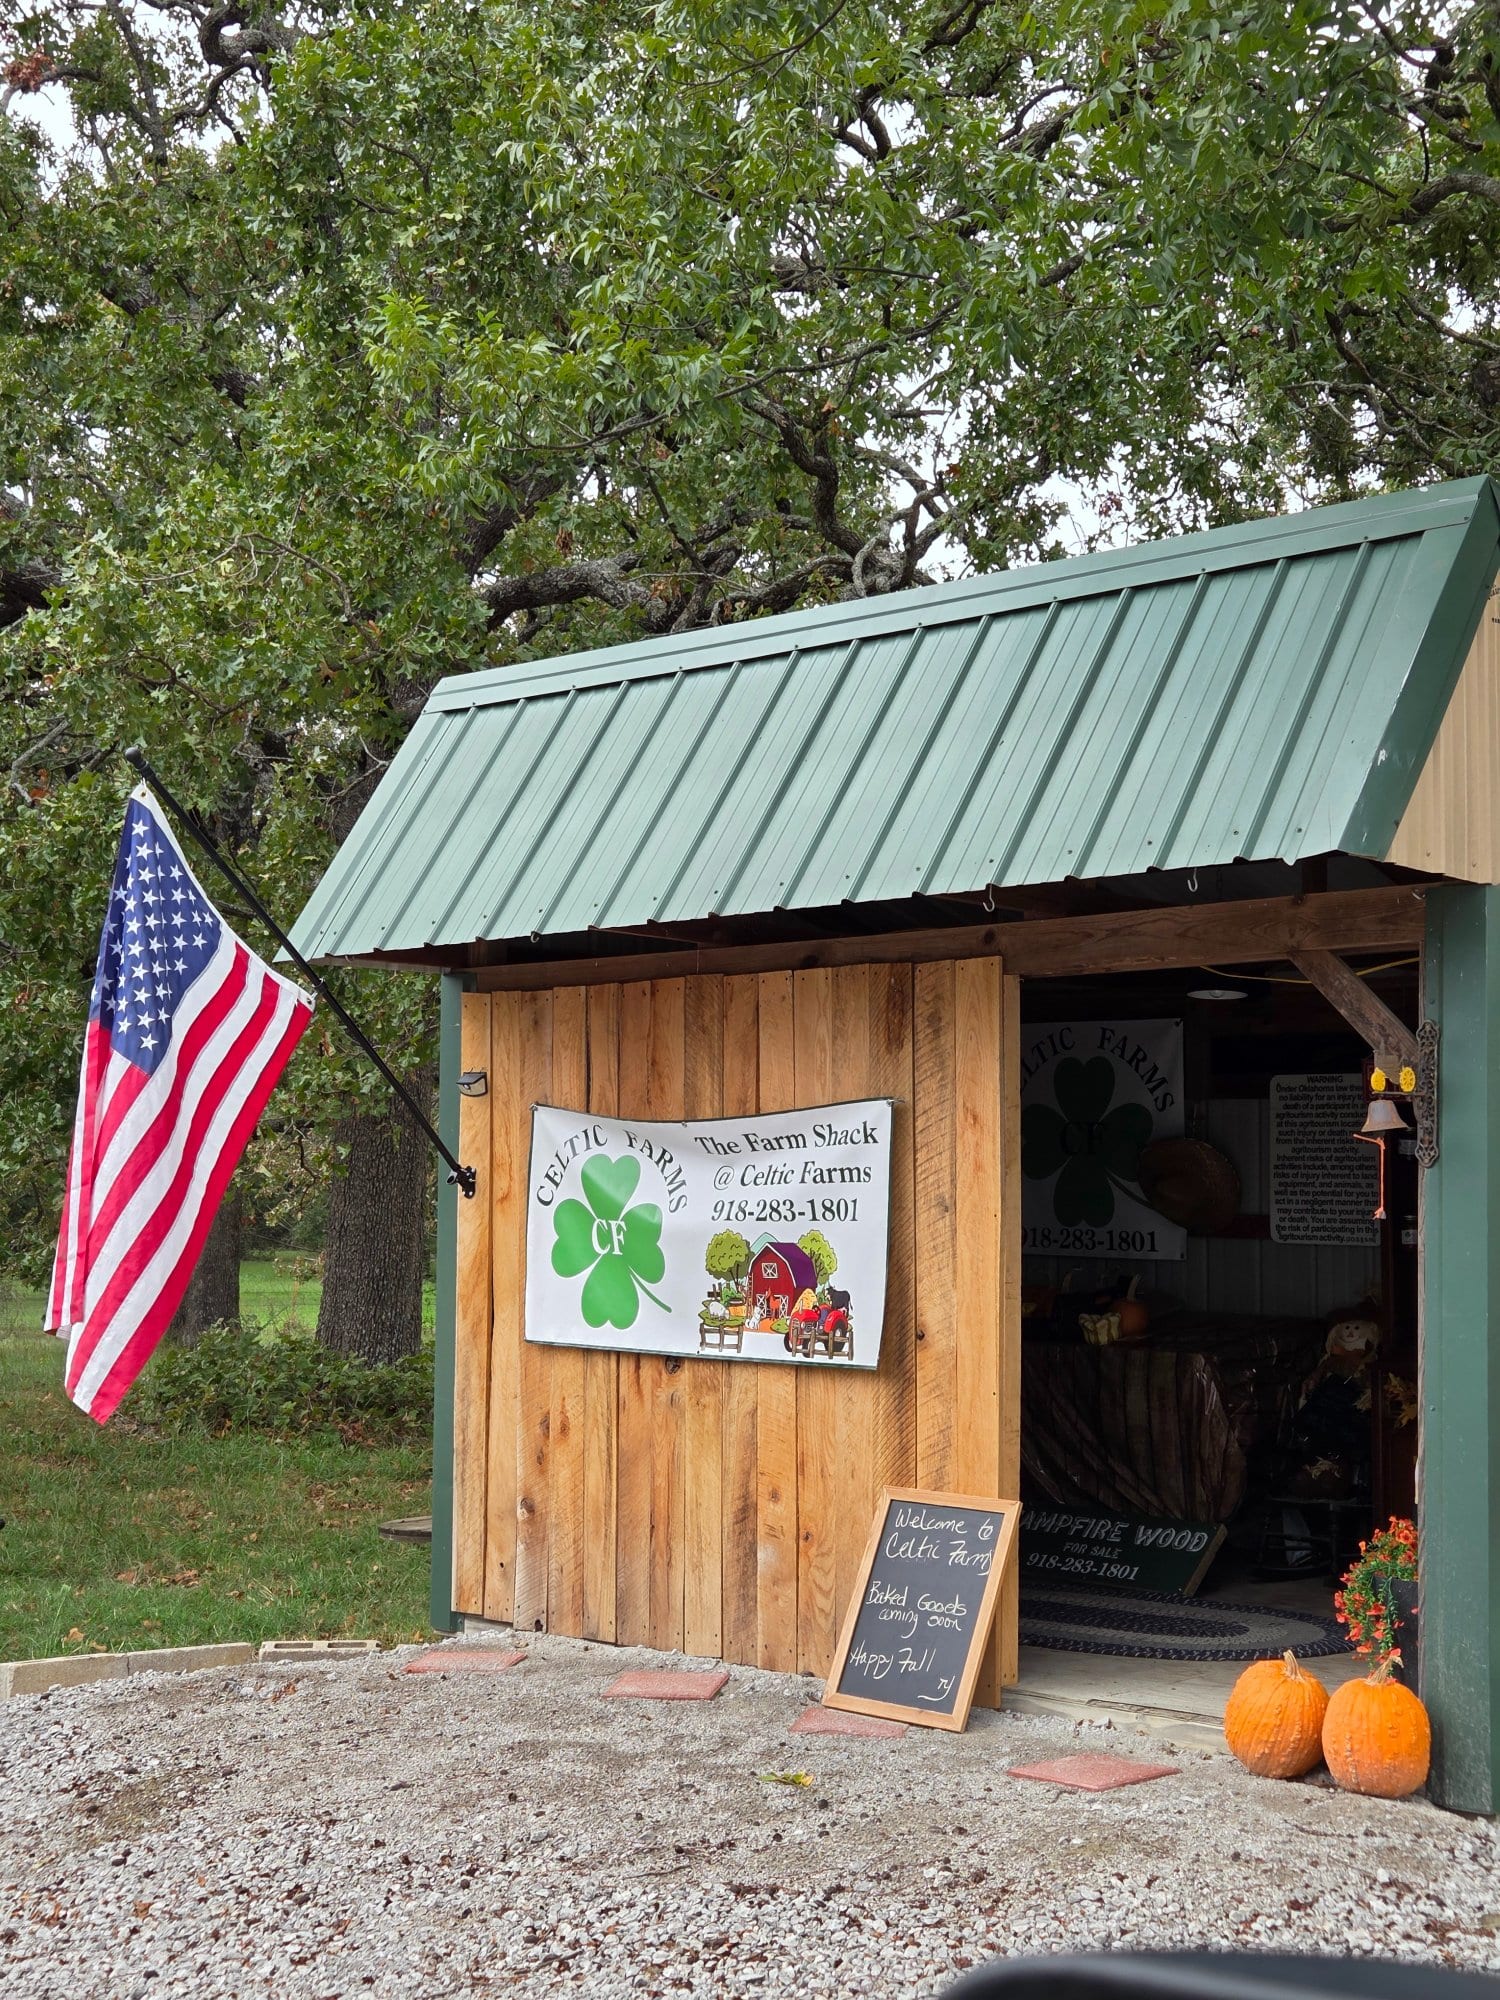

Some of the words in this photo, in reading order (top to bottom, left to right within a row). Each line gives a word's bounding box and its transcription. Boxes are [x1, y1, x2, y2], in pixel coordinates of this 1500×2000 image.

[1021, 1027, 1076, 1090] LTIC
[1097, 1026, 1174, 1113] FARMS
[1299, 1121, 1339, 1129] agritourism
[1314, 1112, 1338, 1120] activity
[694, 1134, 740, 1157] The
[742, 1130, 808, 1152] Farm
[812, 1120, 880, 1148] Shack
[1291, 1146, 1332, 1154] agritourism
[536, 1124, 608, 1207] CELTIC
[624, 1129, 688, 1214] FARMS
[1334, 1154, 1376, 1163] agritourism
[713, 1165, 736, 1191] @
[739, 1162, 795, 1188] Celtic
[799, 1160, 872, 1185] Farms
[1300, 1172, 1320, 1180] injury
[710, 1198, 859, 1223] 918-283-1801
[591, 1218, 627, 1255] CF
[1311, 1225, 1355, 1234] participating
[895, 1508, 968, 1534] Welcome
[978, 1518, 994, 1540] to
[1020, 1510, 1130, 1542] AMPFIRE
[1134, 1524, 1209, 1552] WOOD
[885, 1532, 940, 1559] Celtic
[1063, 1542, 1087, 1555] FOR
[1090, 1547, 1122, 1559] SALE
[1026, 1552, 1140, 1580] 918-283-1801
[866, 1581, 909, 1607] Baked
[917, 1593, 967, 1616] Goods
[878, 1607, 918, 1638] coming
[927, 1616, 962, 1631] soon
[849, 1640, 894, 1679] Happy
[899, 1647, 937, 1673] Fall
